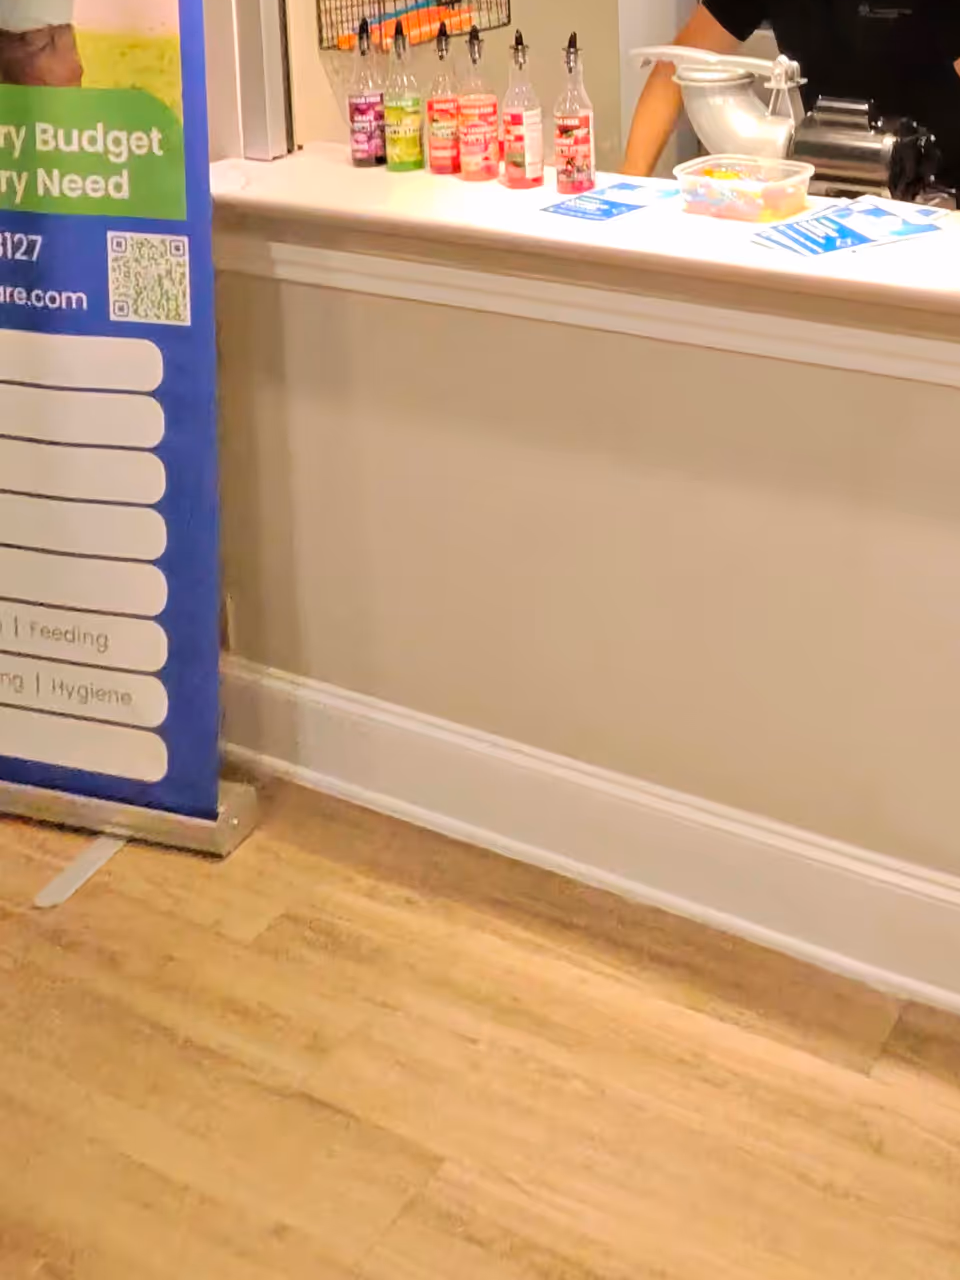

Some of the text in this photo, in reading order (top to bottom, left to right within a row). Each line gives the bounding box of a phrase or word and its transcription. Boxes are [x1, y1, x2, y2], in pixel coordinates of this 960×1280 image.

[35, 121, 163, 164] Budget
[37, 167, 130, 200] Need
[30, 621, 109, 654] Feeding
[51, 677, 133, 706] Hygiene
